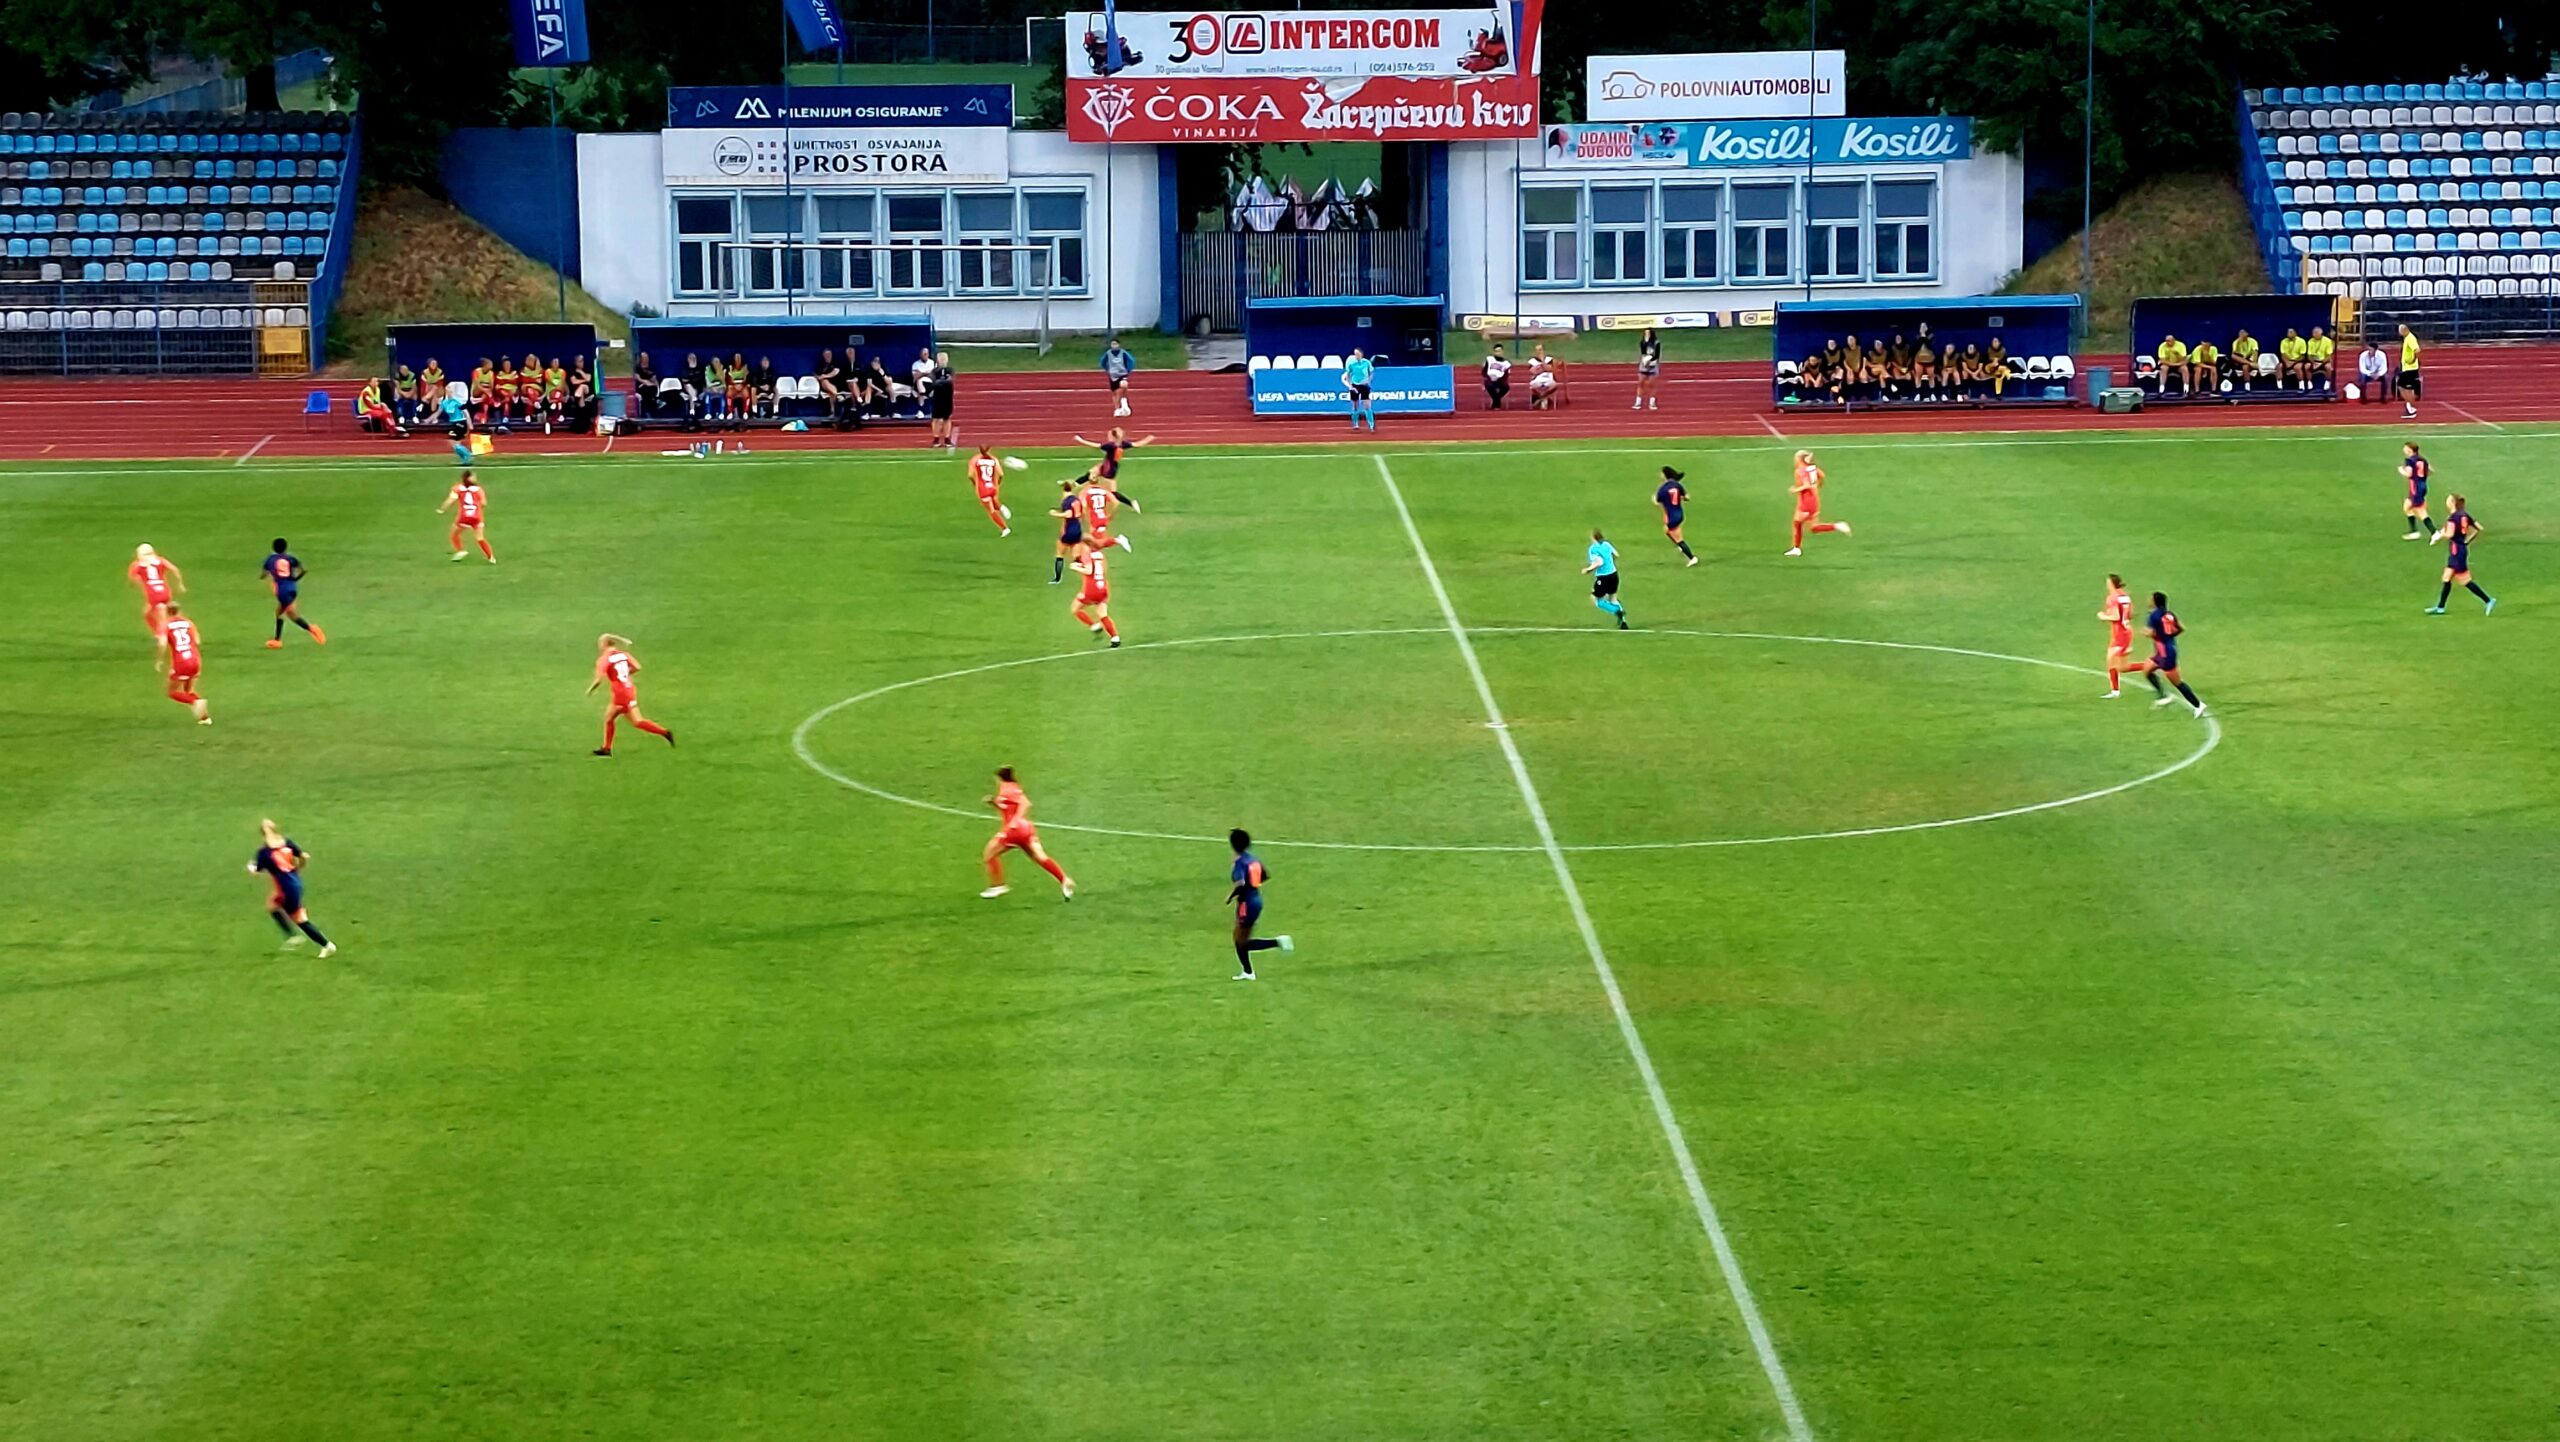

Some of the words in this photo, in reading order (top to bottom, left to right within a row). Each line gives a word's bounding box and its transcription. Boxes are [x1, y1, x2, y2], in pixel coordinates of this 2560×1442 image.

[1168, 13, 1221, 63] 30
[1270, 18, 1440, 49] INTERCOM
[1661, 79, 1830, 98] POLOVNIAUTOMOBILI
[778, 107, 852, 119] MILENIJUM
[855, 106, 942, 118] OSIGURANJE
[1144, 86, 1285, 121] ČOKA
[1173, 127, 1258, 137] VINARIJA
[867, 140, 942, 149] OSVAJANJA
[1577, 145, 1632, 157] DUBOKO
[1698, 126, 1818, 161] Kosili
[1839, 123, 1958, 158] Kosili
[794, 154, 948, 172] PROSTORA
[1408, 390, 1449, 400] LEAGUE
